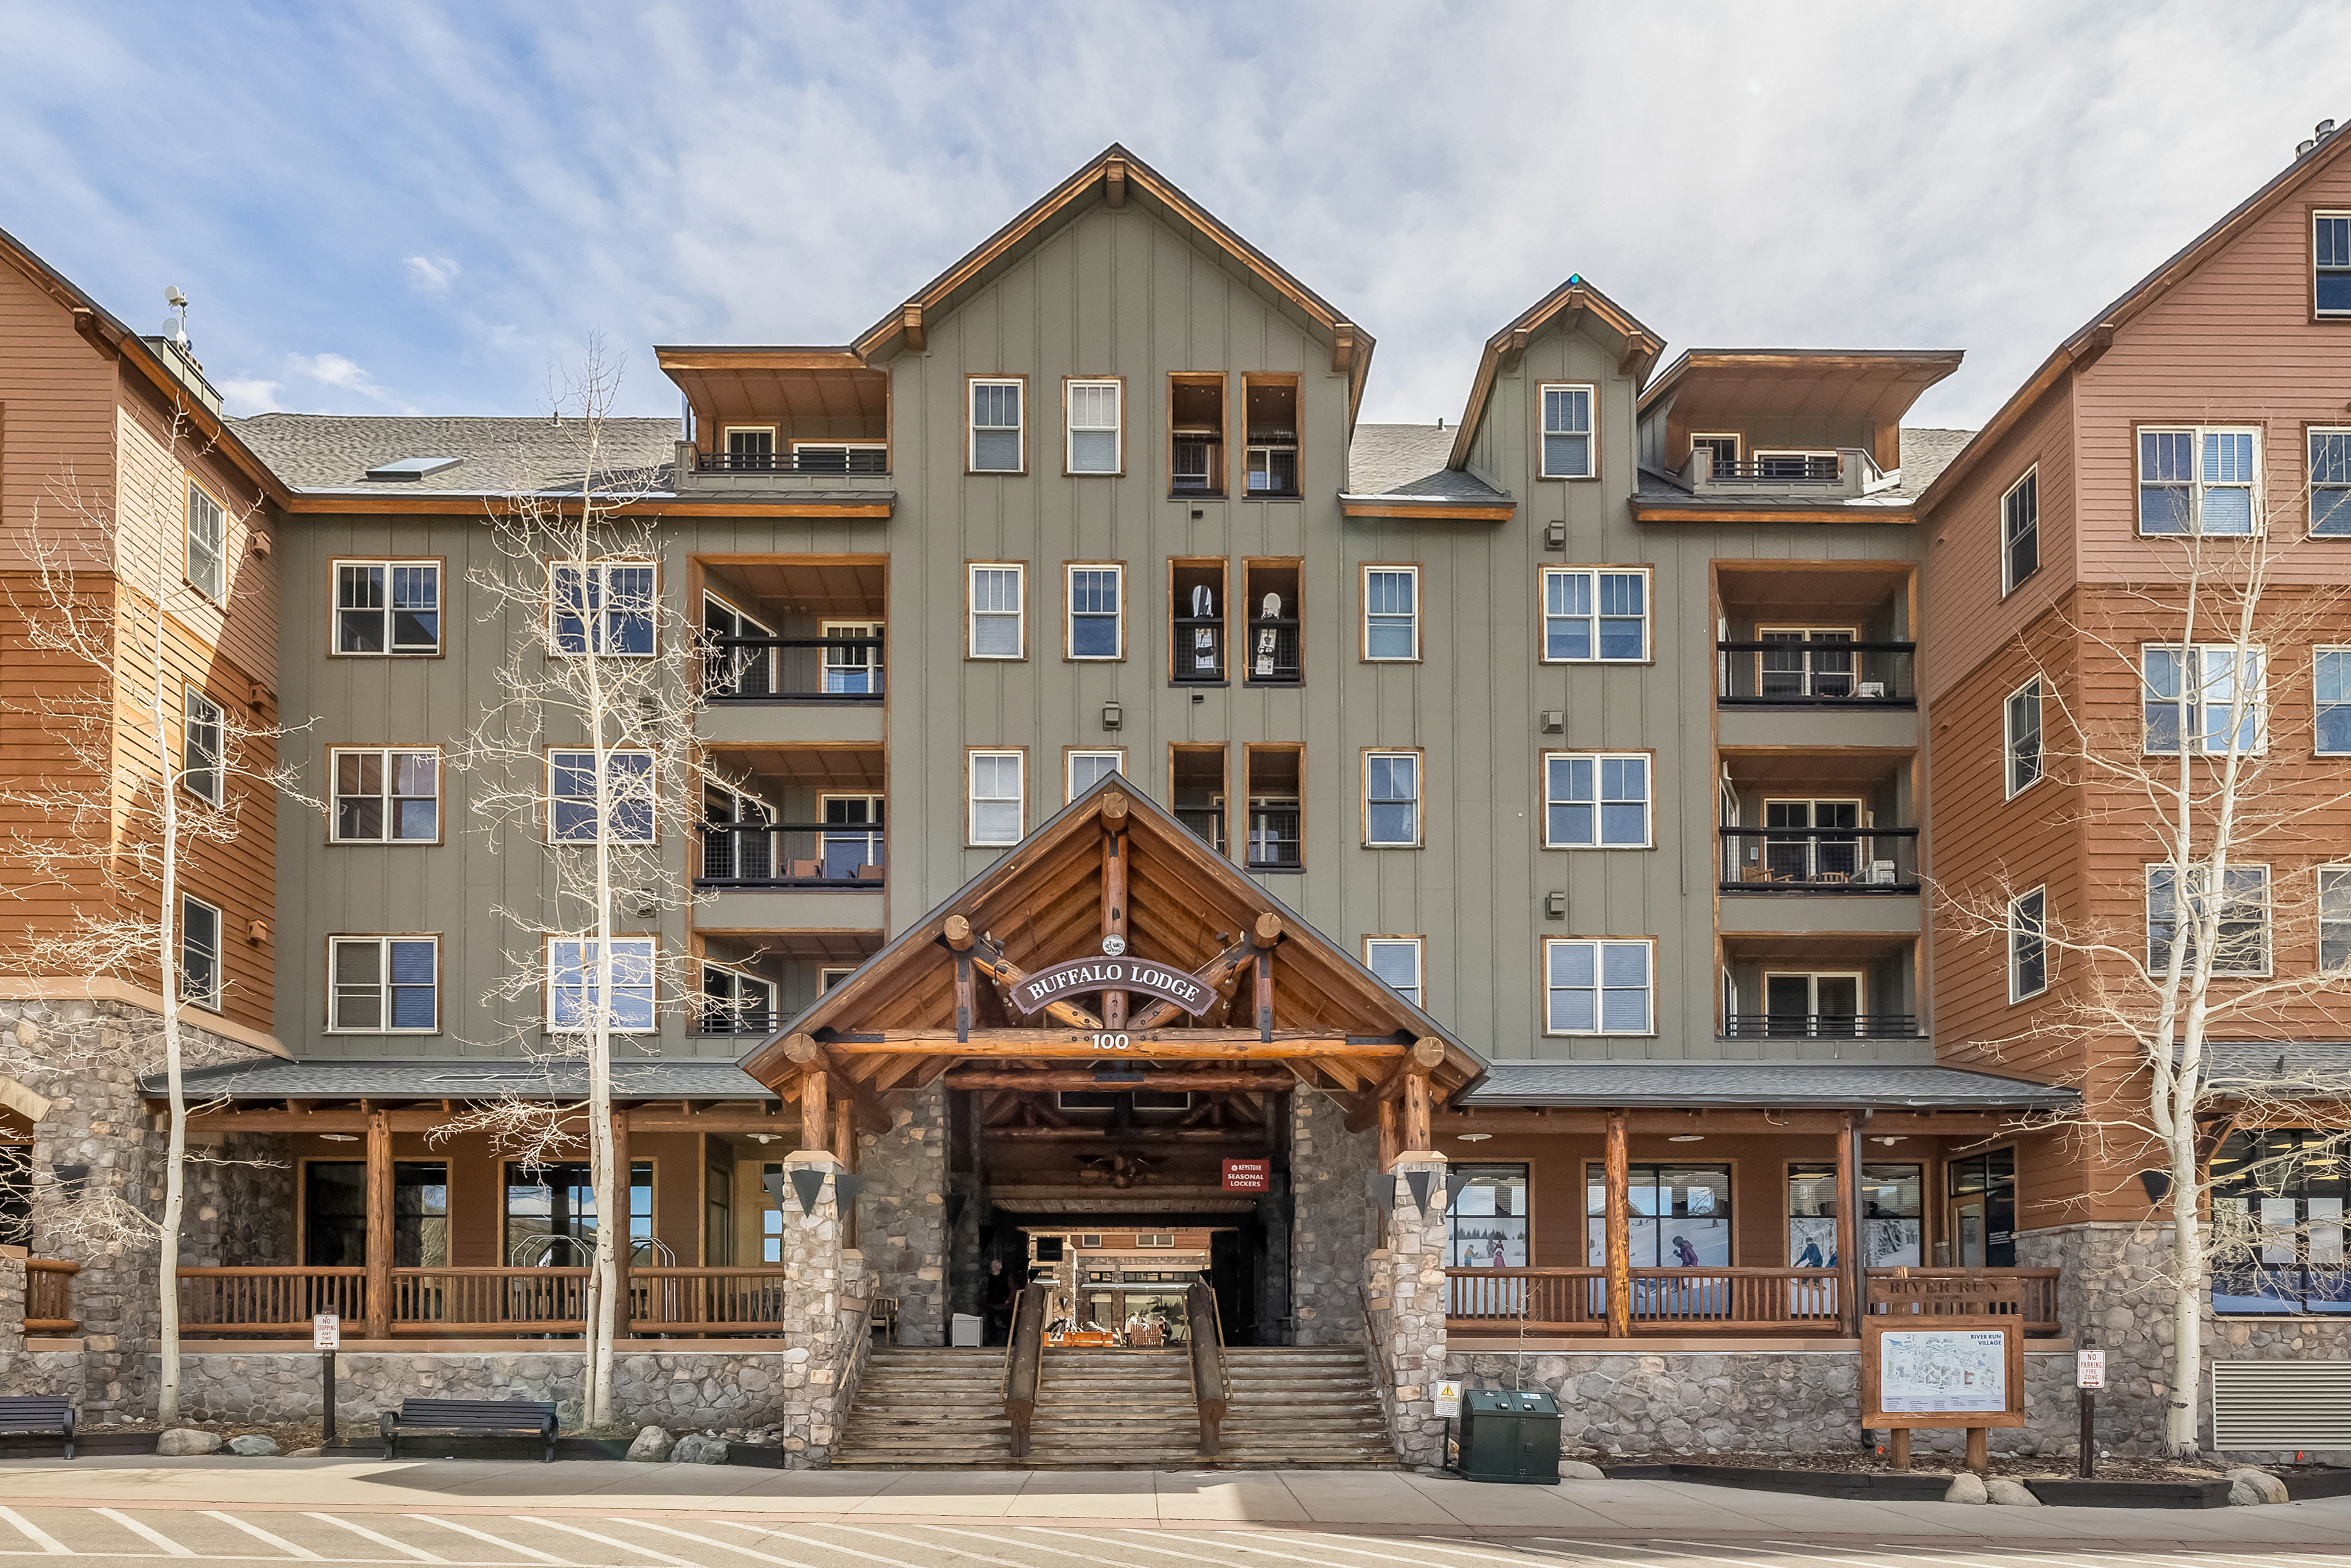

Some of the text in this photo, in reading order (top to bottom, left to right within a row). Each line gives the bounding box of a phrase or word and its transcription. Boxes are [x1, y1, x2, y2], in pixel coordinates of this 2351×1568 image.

[1026, 964, 1201, 1002] BUFFALO LODGE
[1092, 1034, 1129, 1049] 100
[1890, 1281, 1999, 1293] RIVER RUN
